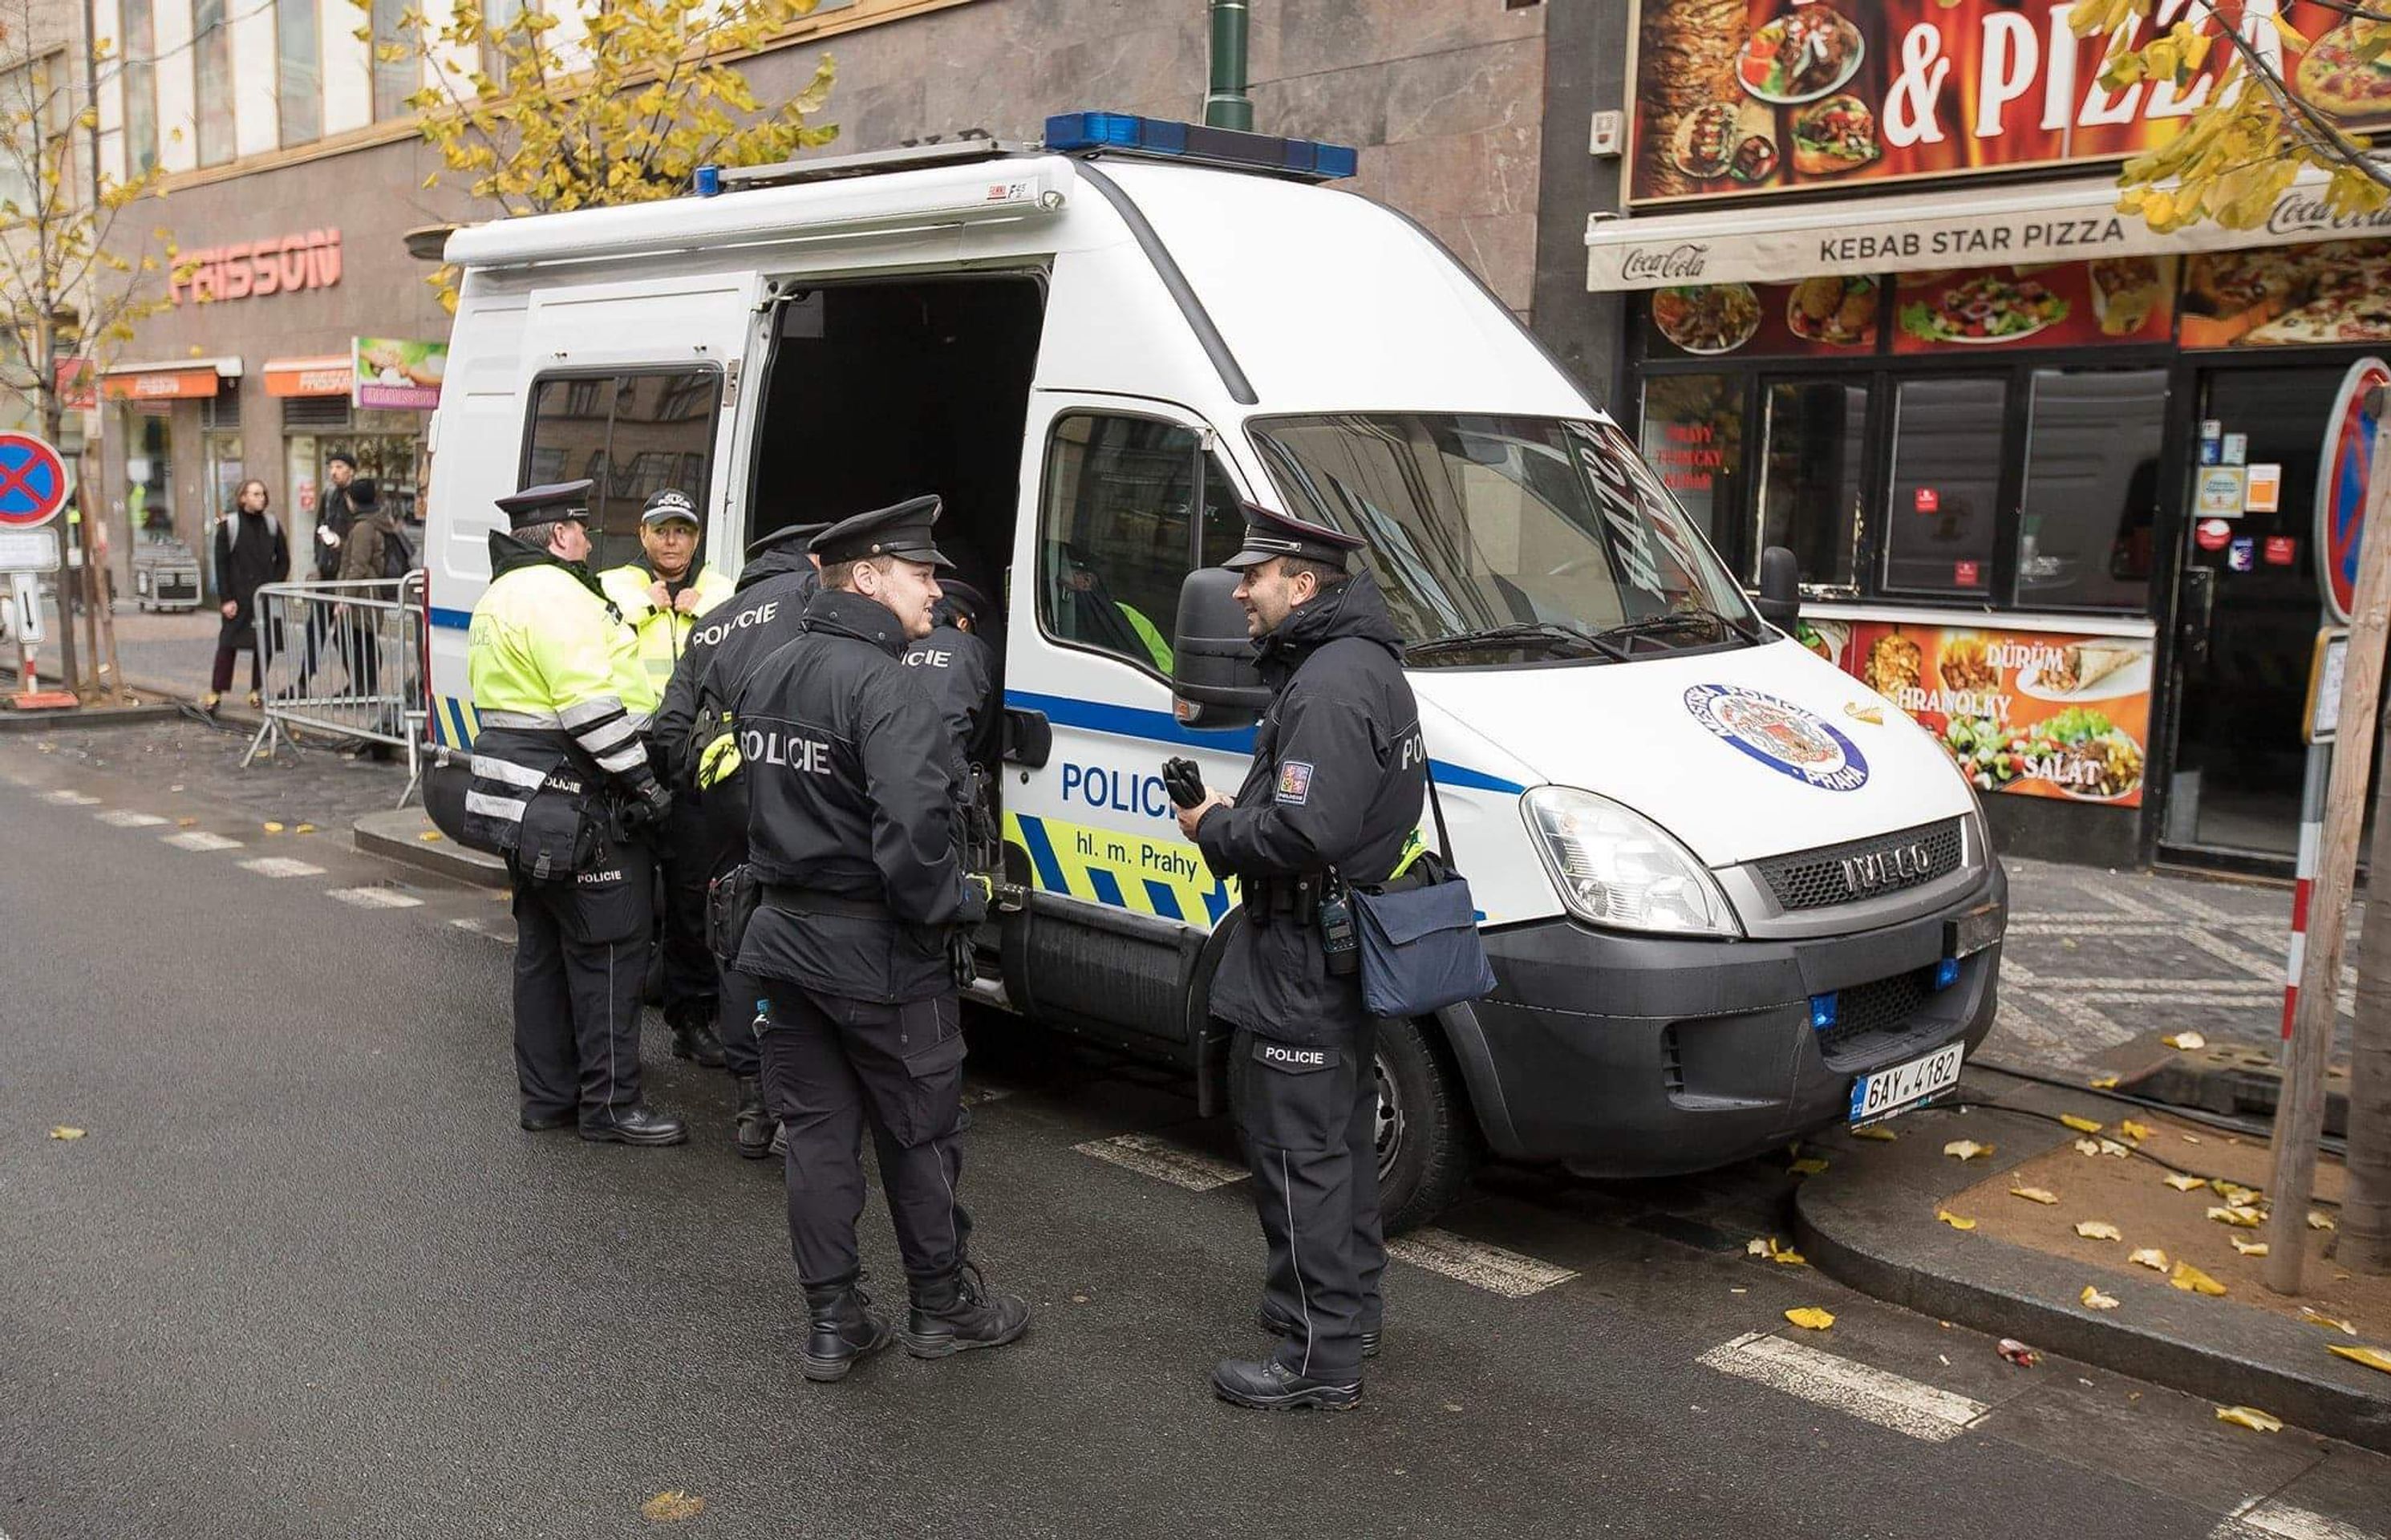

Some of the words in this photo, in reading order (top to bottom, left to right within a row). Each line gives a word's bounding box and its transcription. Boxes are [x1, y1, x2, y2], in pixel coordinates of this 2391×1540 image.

[1882, 22, 1951, 148] &
[1820, 233, 1921, 261] KEBAB
[1931, 228, 2011, 254] STAR
[2024, 218, 2125, 247] PIZZA
[169, 229, 341, 305] FRISSON
[1986, 639, 2064, 672] DÜRÜM
[1897, 686, 2013, 723] HRANOLKY
[741, 729, 831, 775] POLCIE
[545, 776, 582, 794] OLICIE
[1805, 764, 1866, 791] PRAHA
[577, 869, 622, 883] POLICIE
[1076, 831, 1097, 857] hl.
[1108, 843, 1131, 864] m.
[1141, 844, 1198, 882] Prahy
[1842, 845, 1931, 892] IVECO
[1266, 1047, 1323, 1064] POLICIE
[1869, 1070, 1903, 1108] 6AY
[1914, 1052, 1955, 1092] 4182
